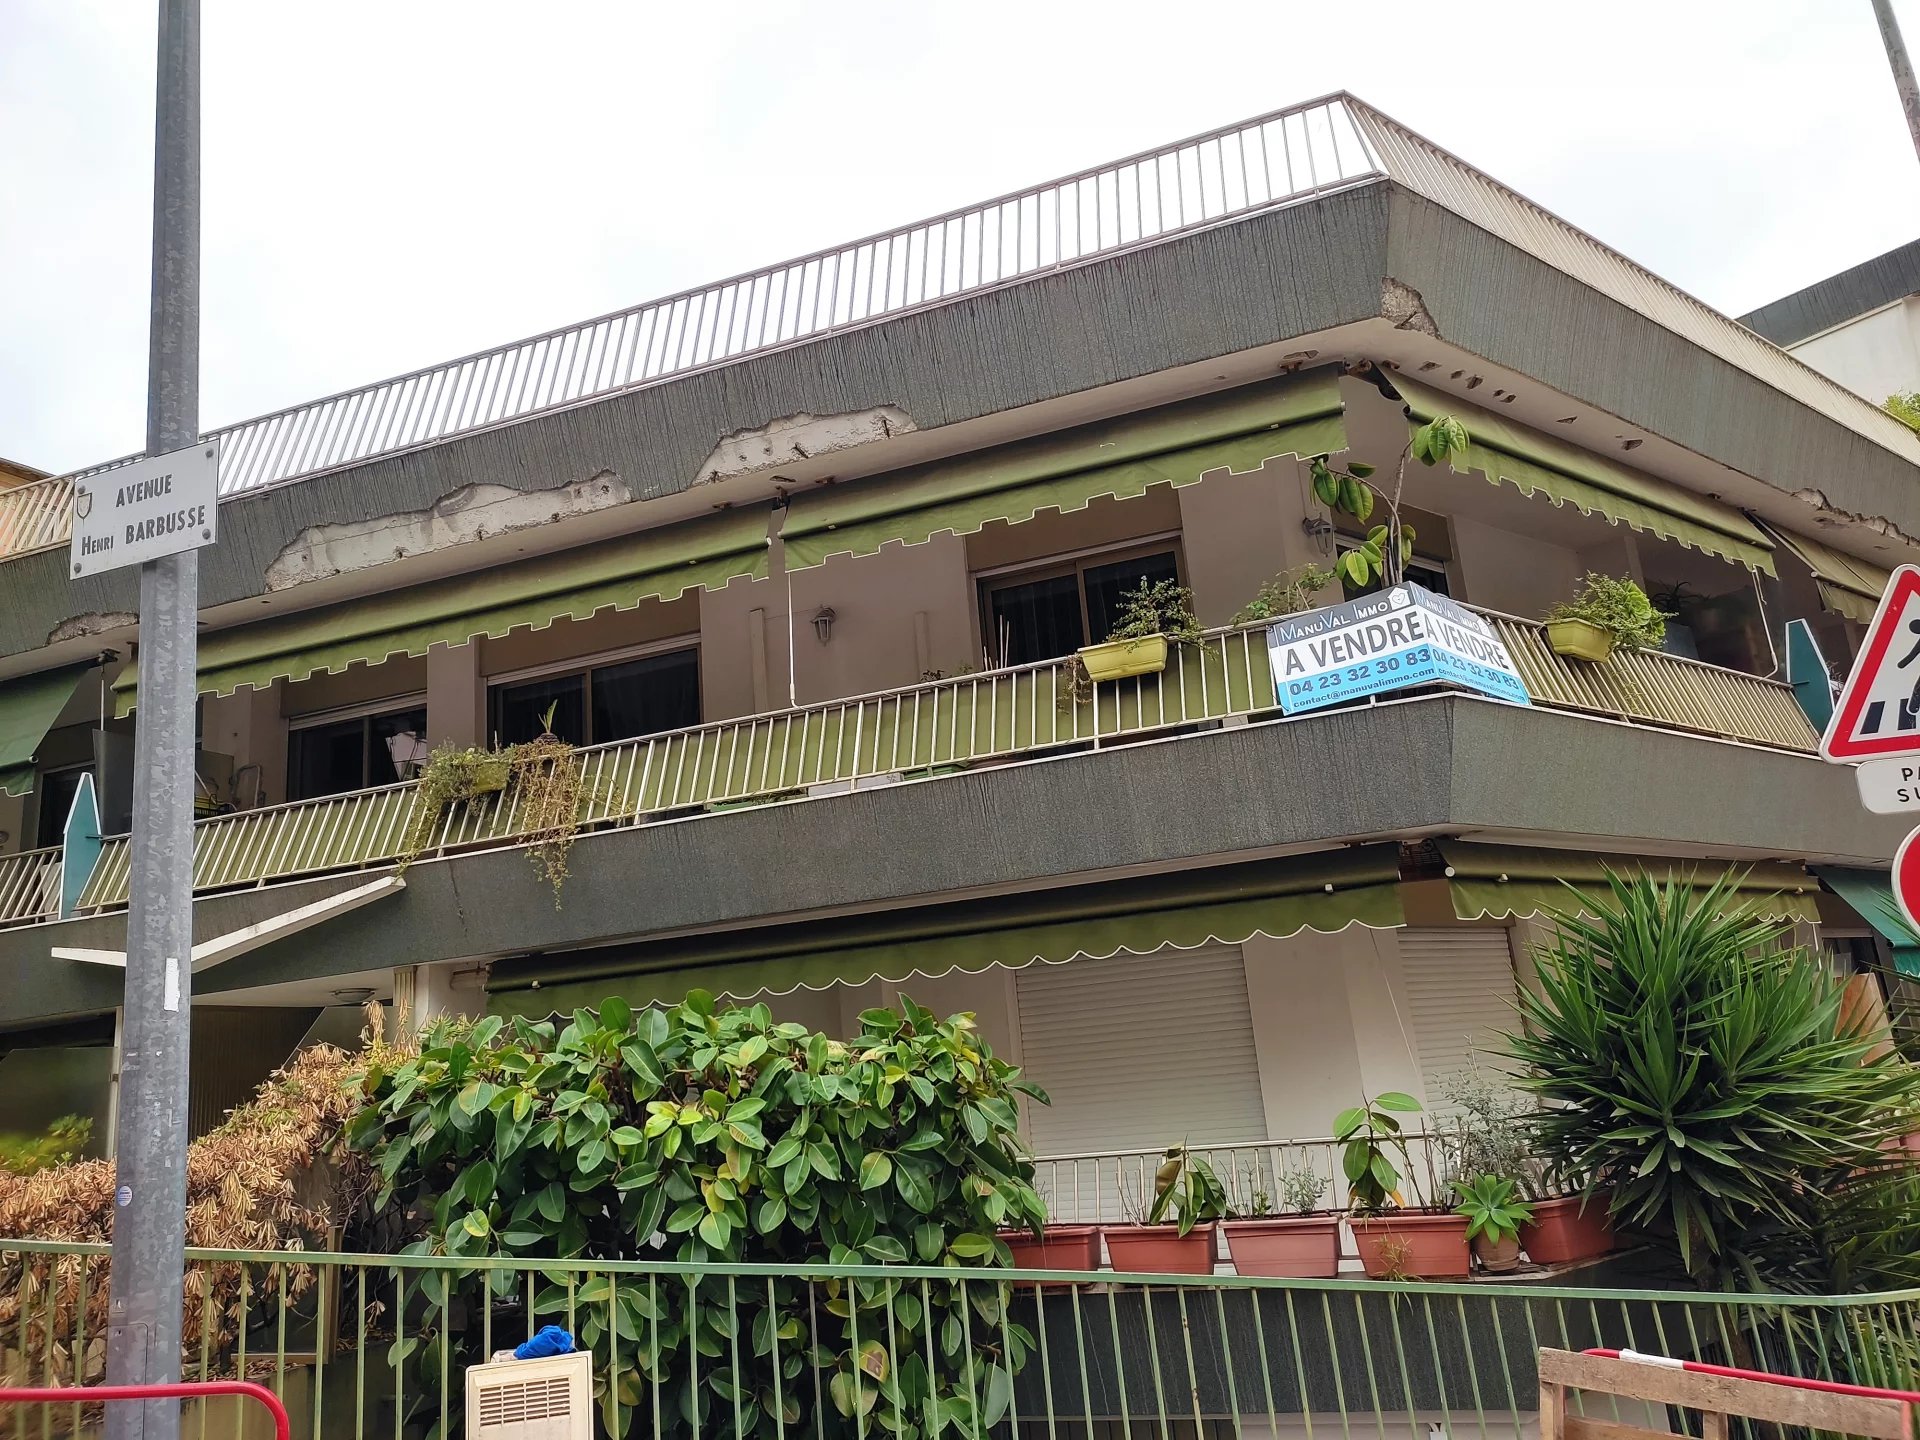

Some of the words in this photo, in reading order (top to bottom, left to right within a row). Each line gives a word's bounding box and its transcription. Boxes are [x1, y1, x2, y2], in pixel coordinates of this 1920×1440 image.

[115, 473, 173, 508] AVENUE
[125, 504, 206, 545] BARBUSSE
[1285, 648, 1306, 676] A
[1308, 610, 1425, 668] VENDRE
[1423, 612, 1440, 643] A
[1436, 619, 1510, 670] VENDRE
[1289, 680, 1314, 696] 04
[1318, 673, 1342, 690] 23
[1346, 665, 1371, 682] 32
[1375, 657, 1400, 674] 30
[1405, 648, 1431, 666] 83
[1293, 667, 1435, 708] contact@manuvalimmo.com
[1432, 648, 1449, 665] 04
[1449, 655, 1467, 672] 23
[1467, 661, 1485, 678] 32
[1484, 668, 1502, 684] 30
[1503, 676, 1520, 690] 83
[1901, 766, 1920, 782] P
